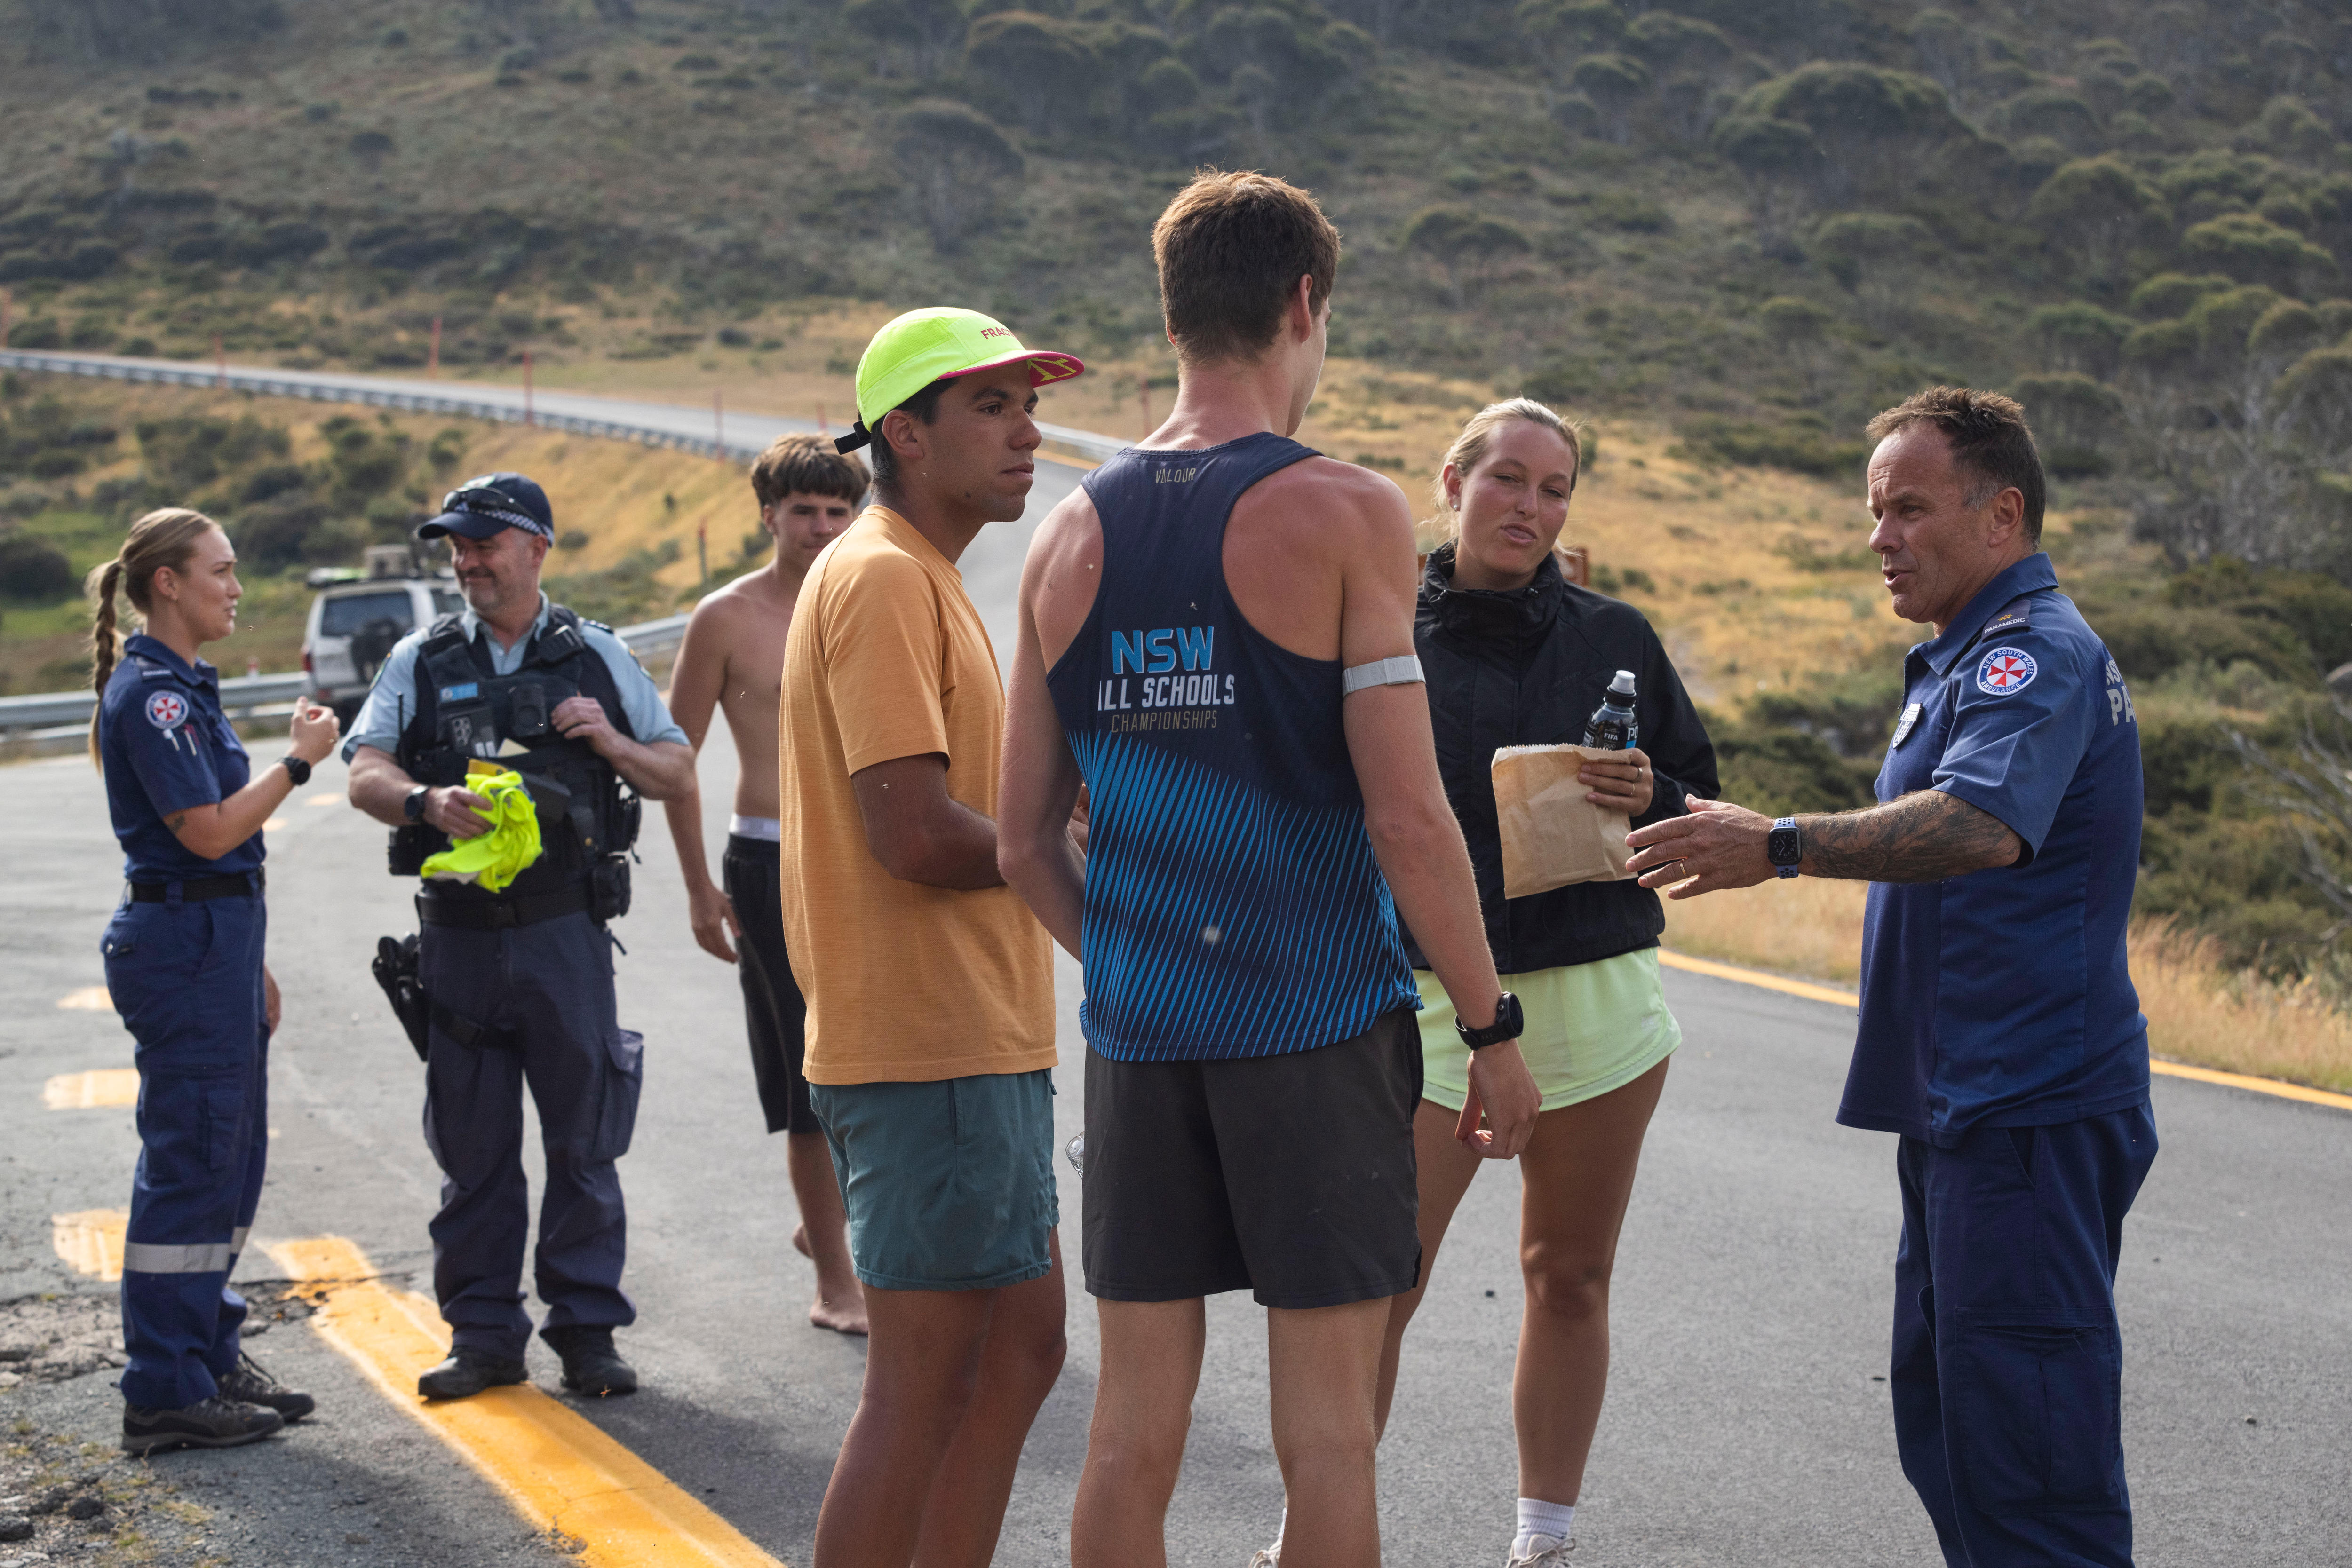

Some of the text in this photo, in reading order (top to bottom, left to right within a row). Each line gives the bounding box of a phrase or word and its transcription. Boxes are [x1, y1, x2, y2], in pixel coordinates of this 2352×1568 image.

[1155, 468, 1196, 484] VALOUR
[1984, 618, 2026, 634] PARAMEDIC
[1112, 626, 1214, 674] NSW
[1983, 654, 1996, 669] NEW
[2022, 657, 2034, 675] WALES
[2106, 659, 2123, 686] NS
[1142, 674, 1235, 708] SCHOOLS
[1980, 681, 2021, 693] AMBULANCE
[1112, 710, 1217, 733] CHAMPIONSHIPS
